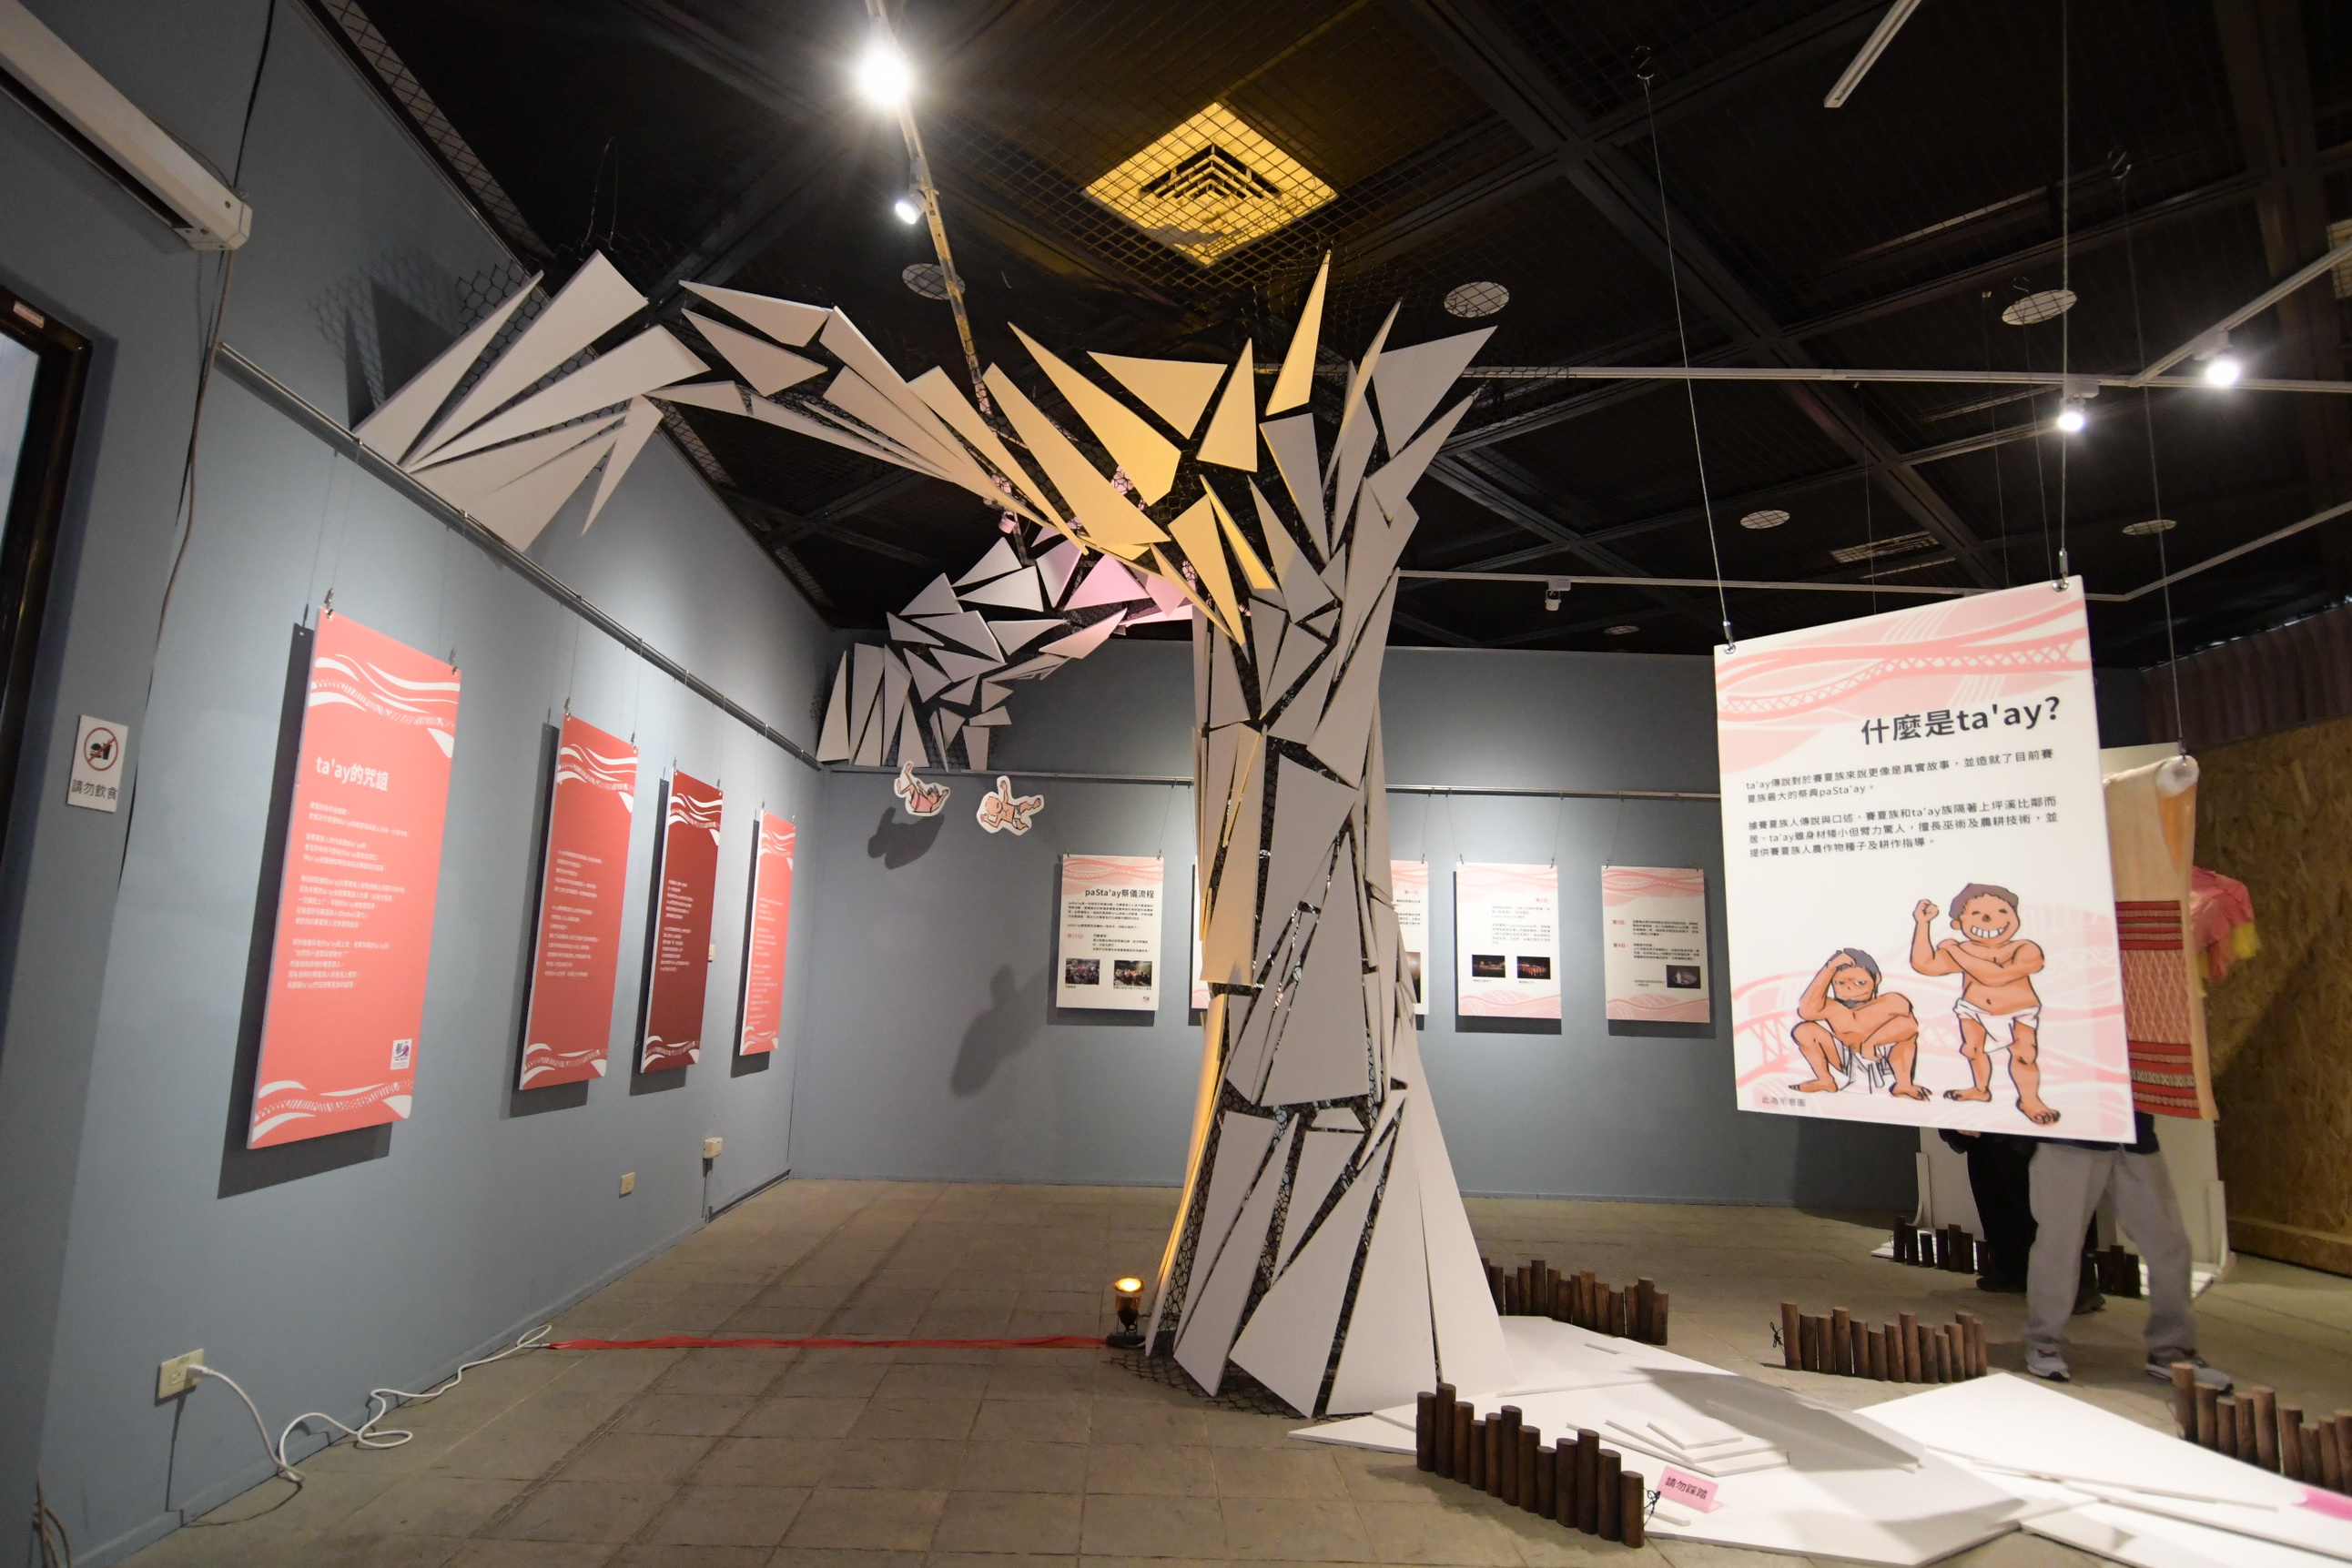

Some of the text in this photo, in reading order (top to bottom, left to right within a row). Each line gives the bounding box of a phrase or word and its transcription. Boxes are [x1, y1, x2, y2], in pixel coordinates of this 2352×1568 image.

[1861, 696, 2060, 745] 什麼是ta'ay?
[71, 779, 117, 801] 請勿飲食
[1665, 1476, 1708, 1500] 請勿踩踏
